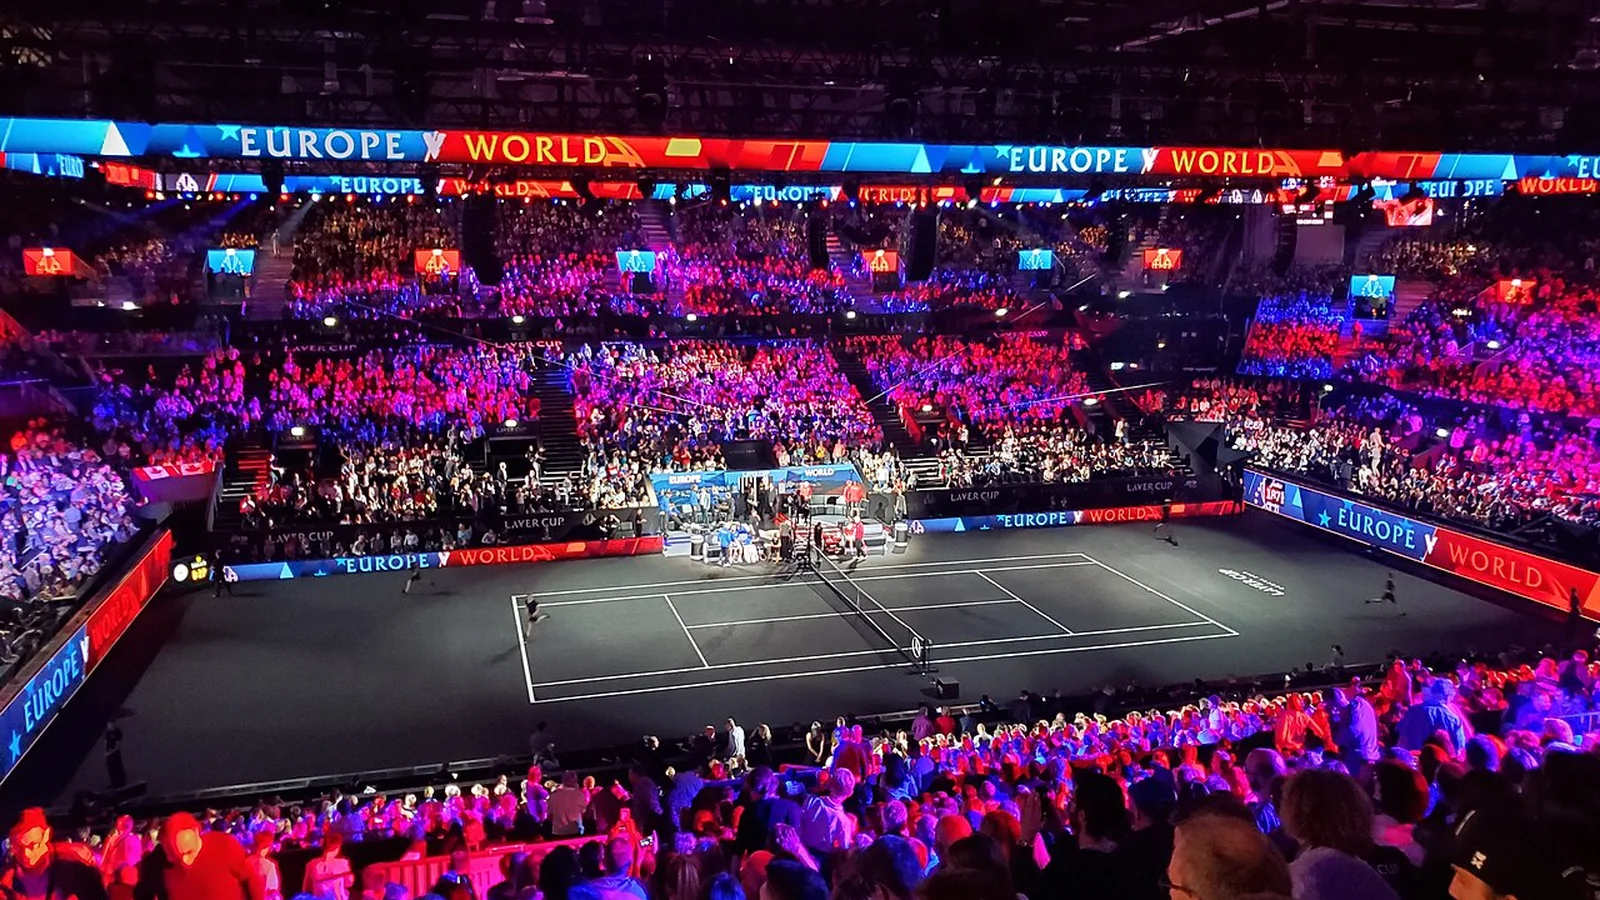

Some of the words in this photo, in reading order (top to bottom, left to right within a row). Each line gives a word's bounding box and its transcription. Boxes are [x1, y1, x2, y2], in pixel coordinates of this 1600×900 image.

[241, 129, 405, 159] EUROPE
[464, 134, 606, 162] WORLD
[1010, 147, 1128, 172] EUROPE
[1171, 150, 1275, 173] WORLD
[341, 177, 424, 194] EUROPE
[1521, 178, 1594, 193] WORLD
[329, 344, 357, 352] CUP
[805, 467, 834, 478] WORLD
[1127, 482, 1153, 491] LAVER
[1154, 481, 1173, 490] CUP
[951, 491, 981, 501] LAVER
[981, 490, 1000, 500] CUP
[505, 518, 539, 529] LAVER
[541, 516, 565, 527] CUP
[1005, 512, 1067, 527] EUROPE
[1090, 507, 1146, 523] WORLD
[308, 531, 333, 541] CUP
[1338, 508, 1416, 550] EUROPE
[1449, 542, 1543, 588] WORLD
[347, 554, 430, 573] EUROPE
[460, 547, 534, 565] WORLD
[23, 650, 80, 733] EUROPE
